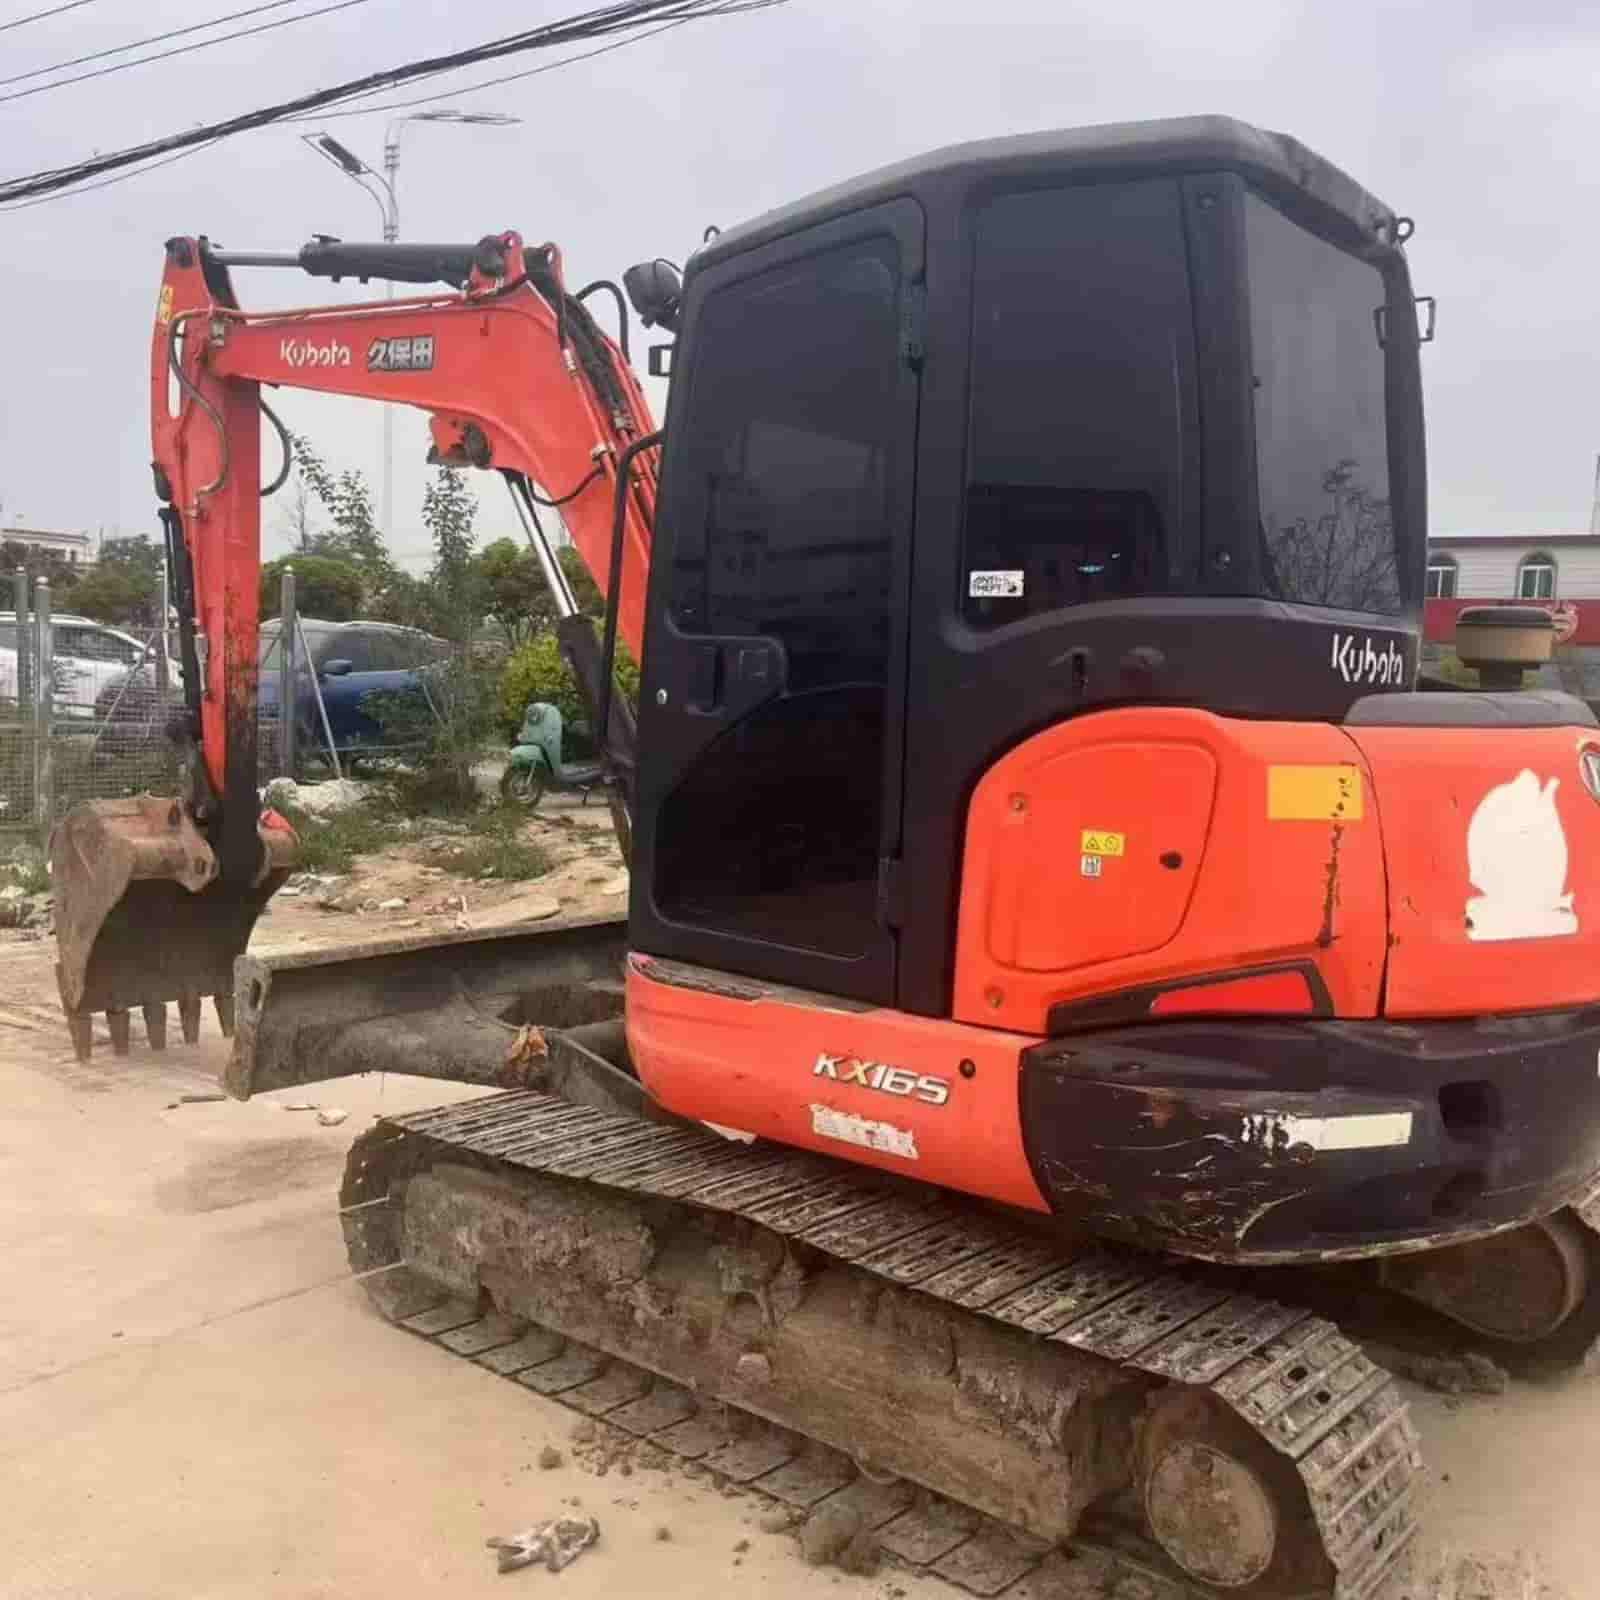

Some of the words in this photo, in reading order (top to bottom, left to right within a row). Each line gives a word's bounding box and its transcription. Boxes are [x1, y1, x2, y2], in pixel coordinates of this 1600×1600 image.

[279, 338, 351, 367] Kubota
[367, 336, 434, 371] 久保田
[1331, 633, 1403, 685] Kubota
